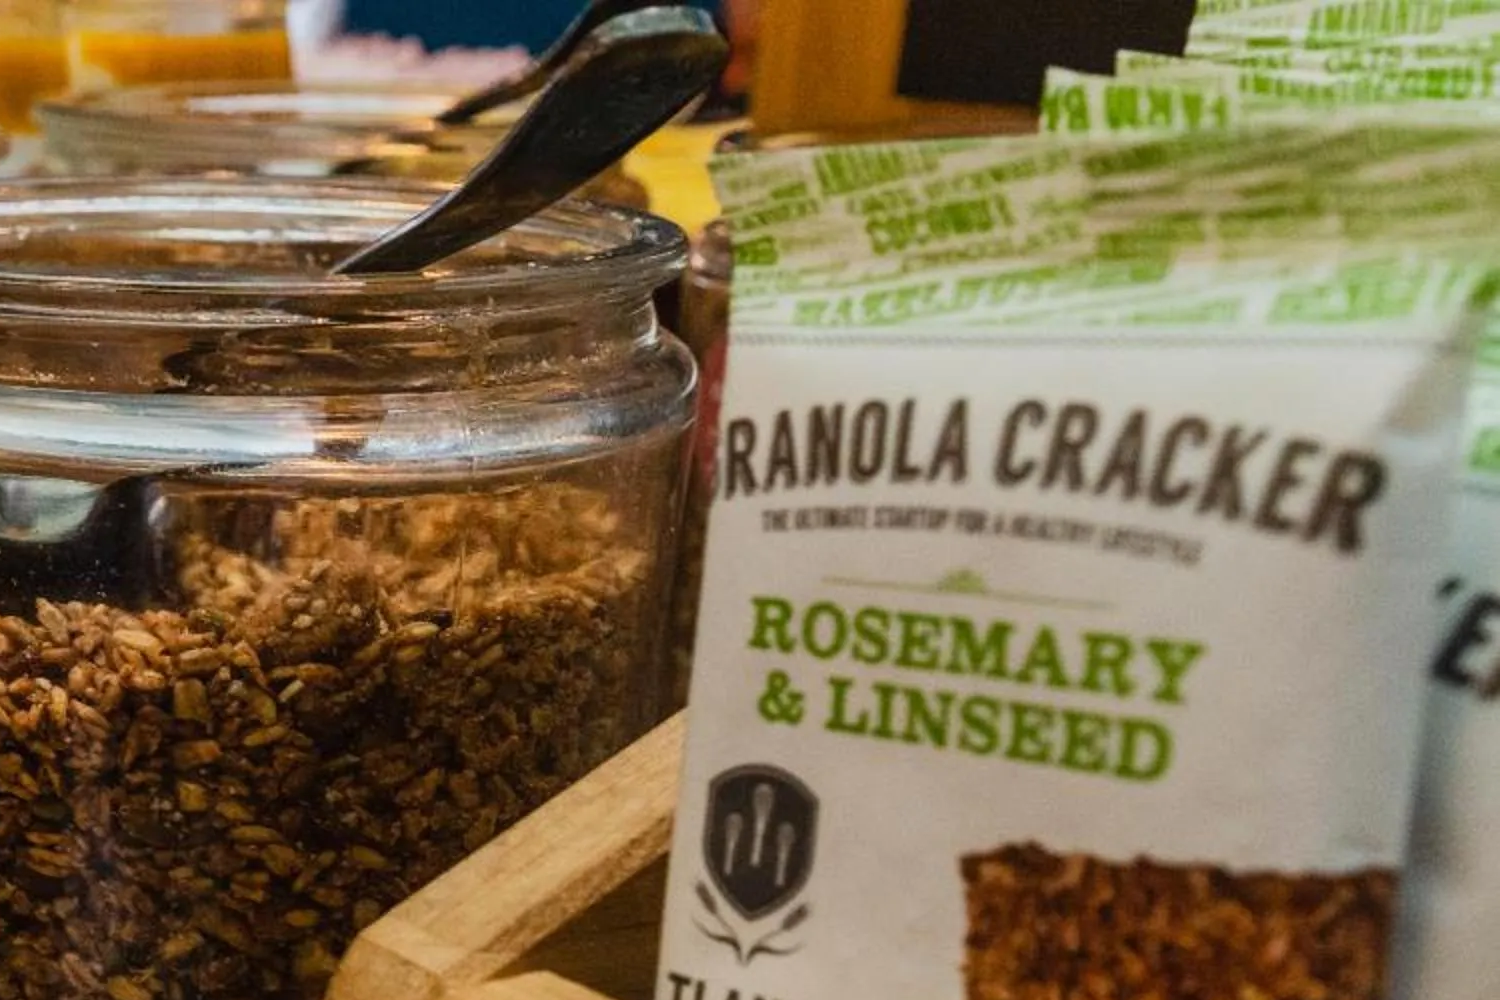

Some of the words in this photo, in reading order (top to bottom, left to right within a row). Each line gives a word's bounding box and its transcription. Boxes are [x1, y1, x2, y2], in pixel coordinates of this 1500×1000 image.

[711, 397, 968, 502] RANOLA
[993, 399, 1391, 556] CRACKER
[761, 508, 789, 533] THE
[794, 505, 868, 530] ULTIMATE
[873, 505, 948, 532] STARTUP
[954, 508, 989, 535] FOR
[747, 595, 1206, 704] ROSEMARY
[756, 669, 805, 727] &
[824, 675, 1176, 784] LINSEED
